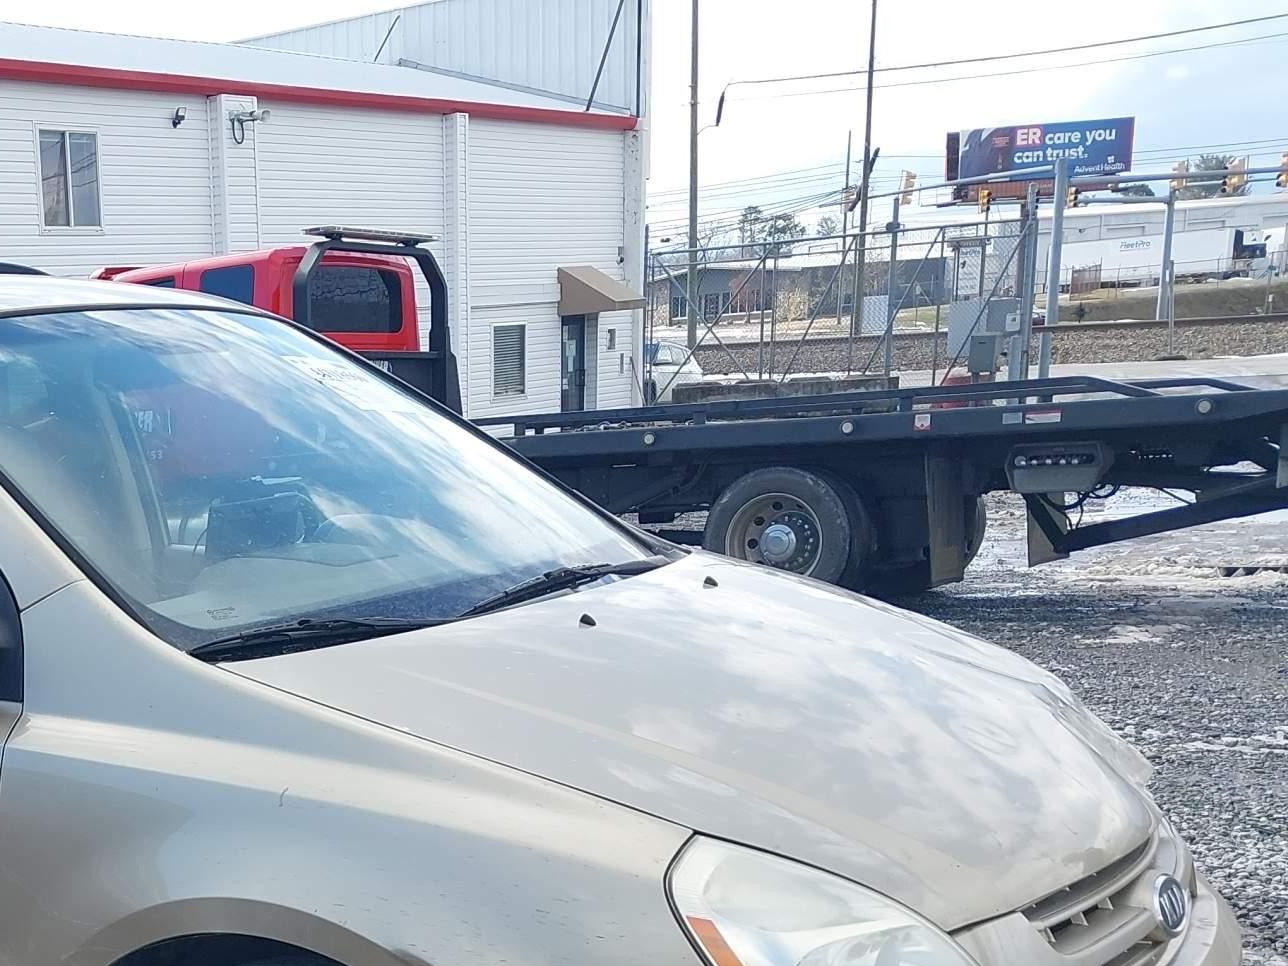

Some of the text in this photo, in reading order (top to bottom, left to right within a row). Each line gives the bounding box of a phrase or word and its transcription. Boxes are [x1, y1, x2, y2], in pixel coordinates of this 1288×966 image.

[1016, 128, 1041, 145] ER
[1045, 131, 1081, 144] care
[1085, 129, 1116, 145] you
[1014, 145, 1088, 163] can trust.
